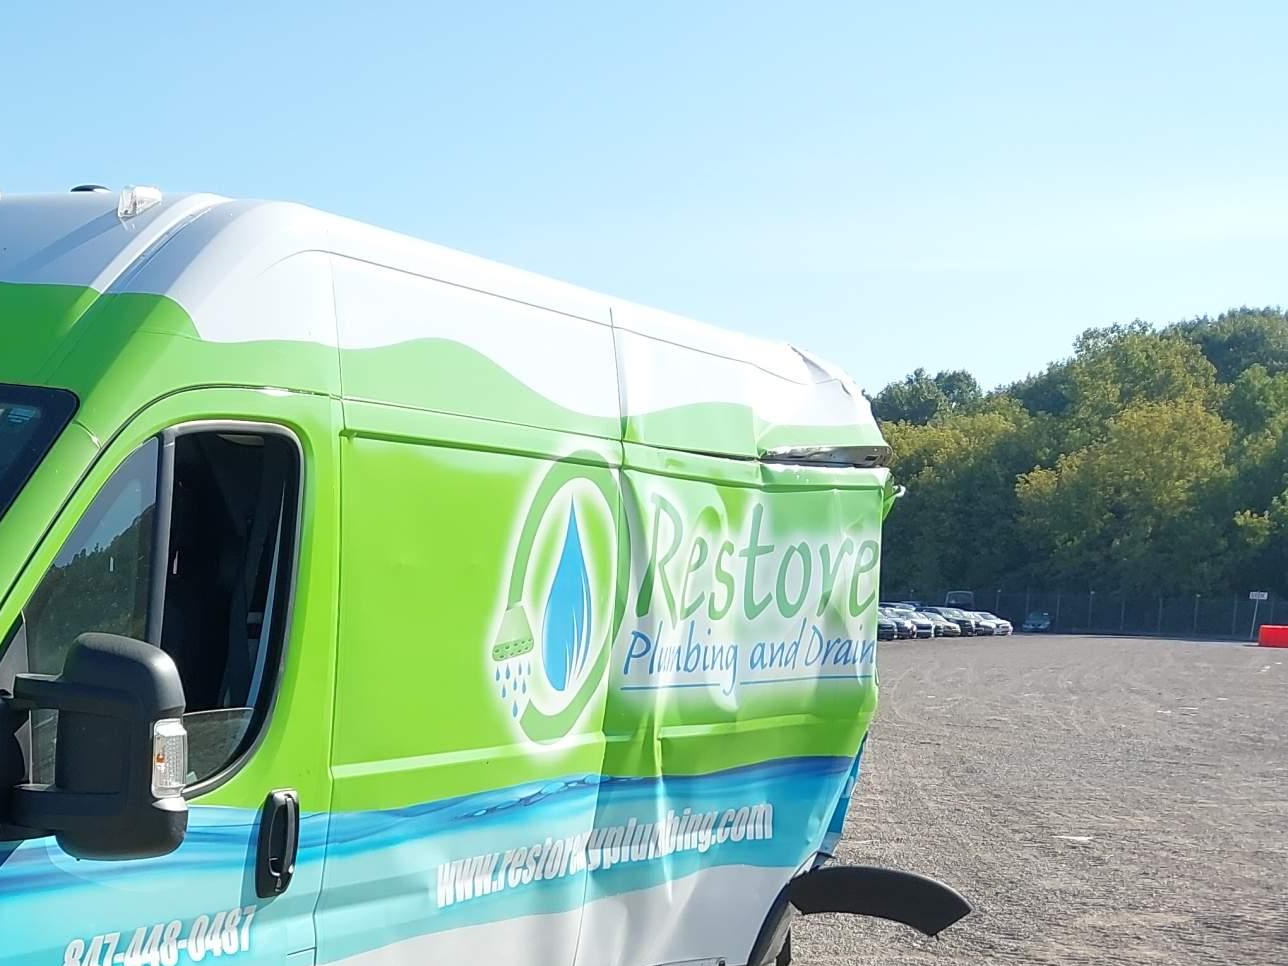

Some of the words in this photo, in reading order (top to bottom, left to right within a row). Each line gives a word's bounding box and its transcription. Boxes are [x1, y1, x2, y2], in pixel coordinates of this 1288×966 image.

[635, 492, 880, 630] Restore
[750, 617, 807, 671] and
[805, 624, 875, 667] Drain
